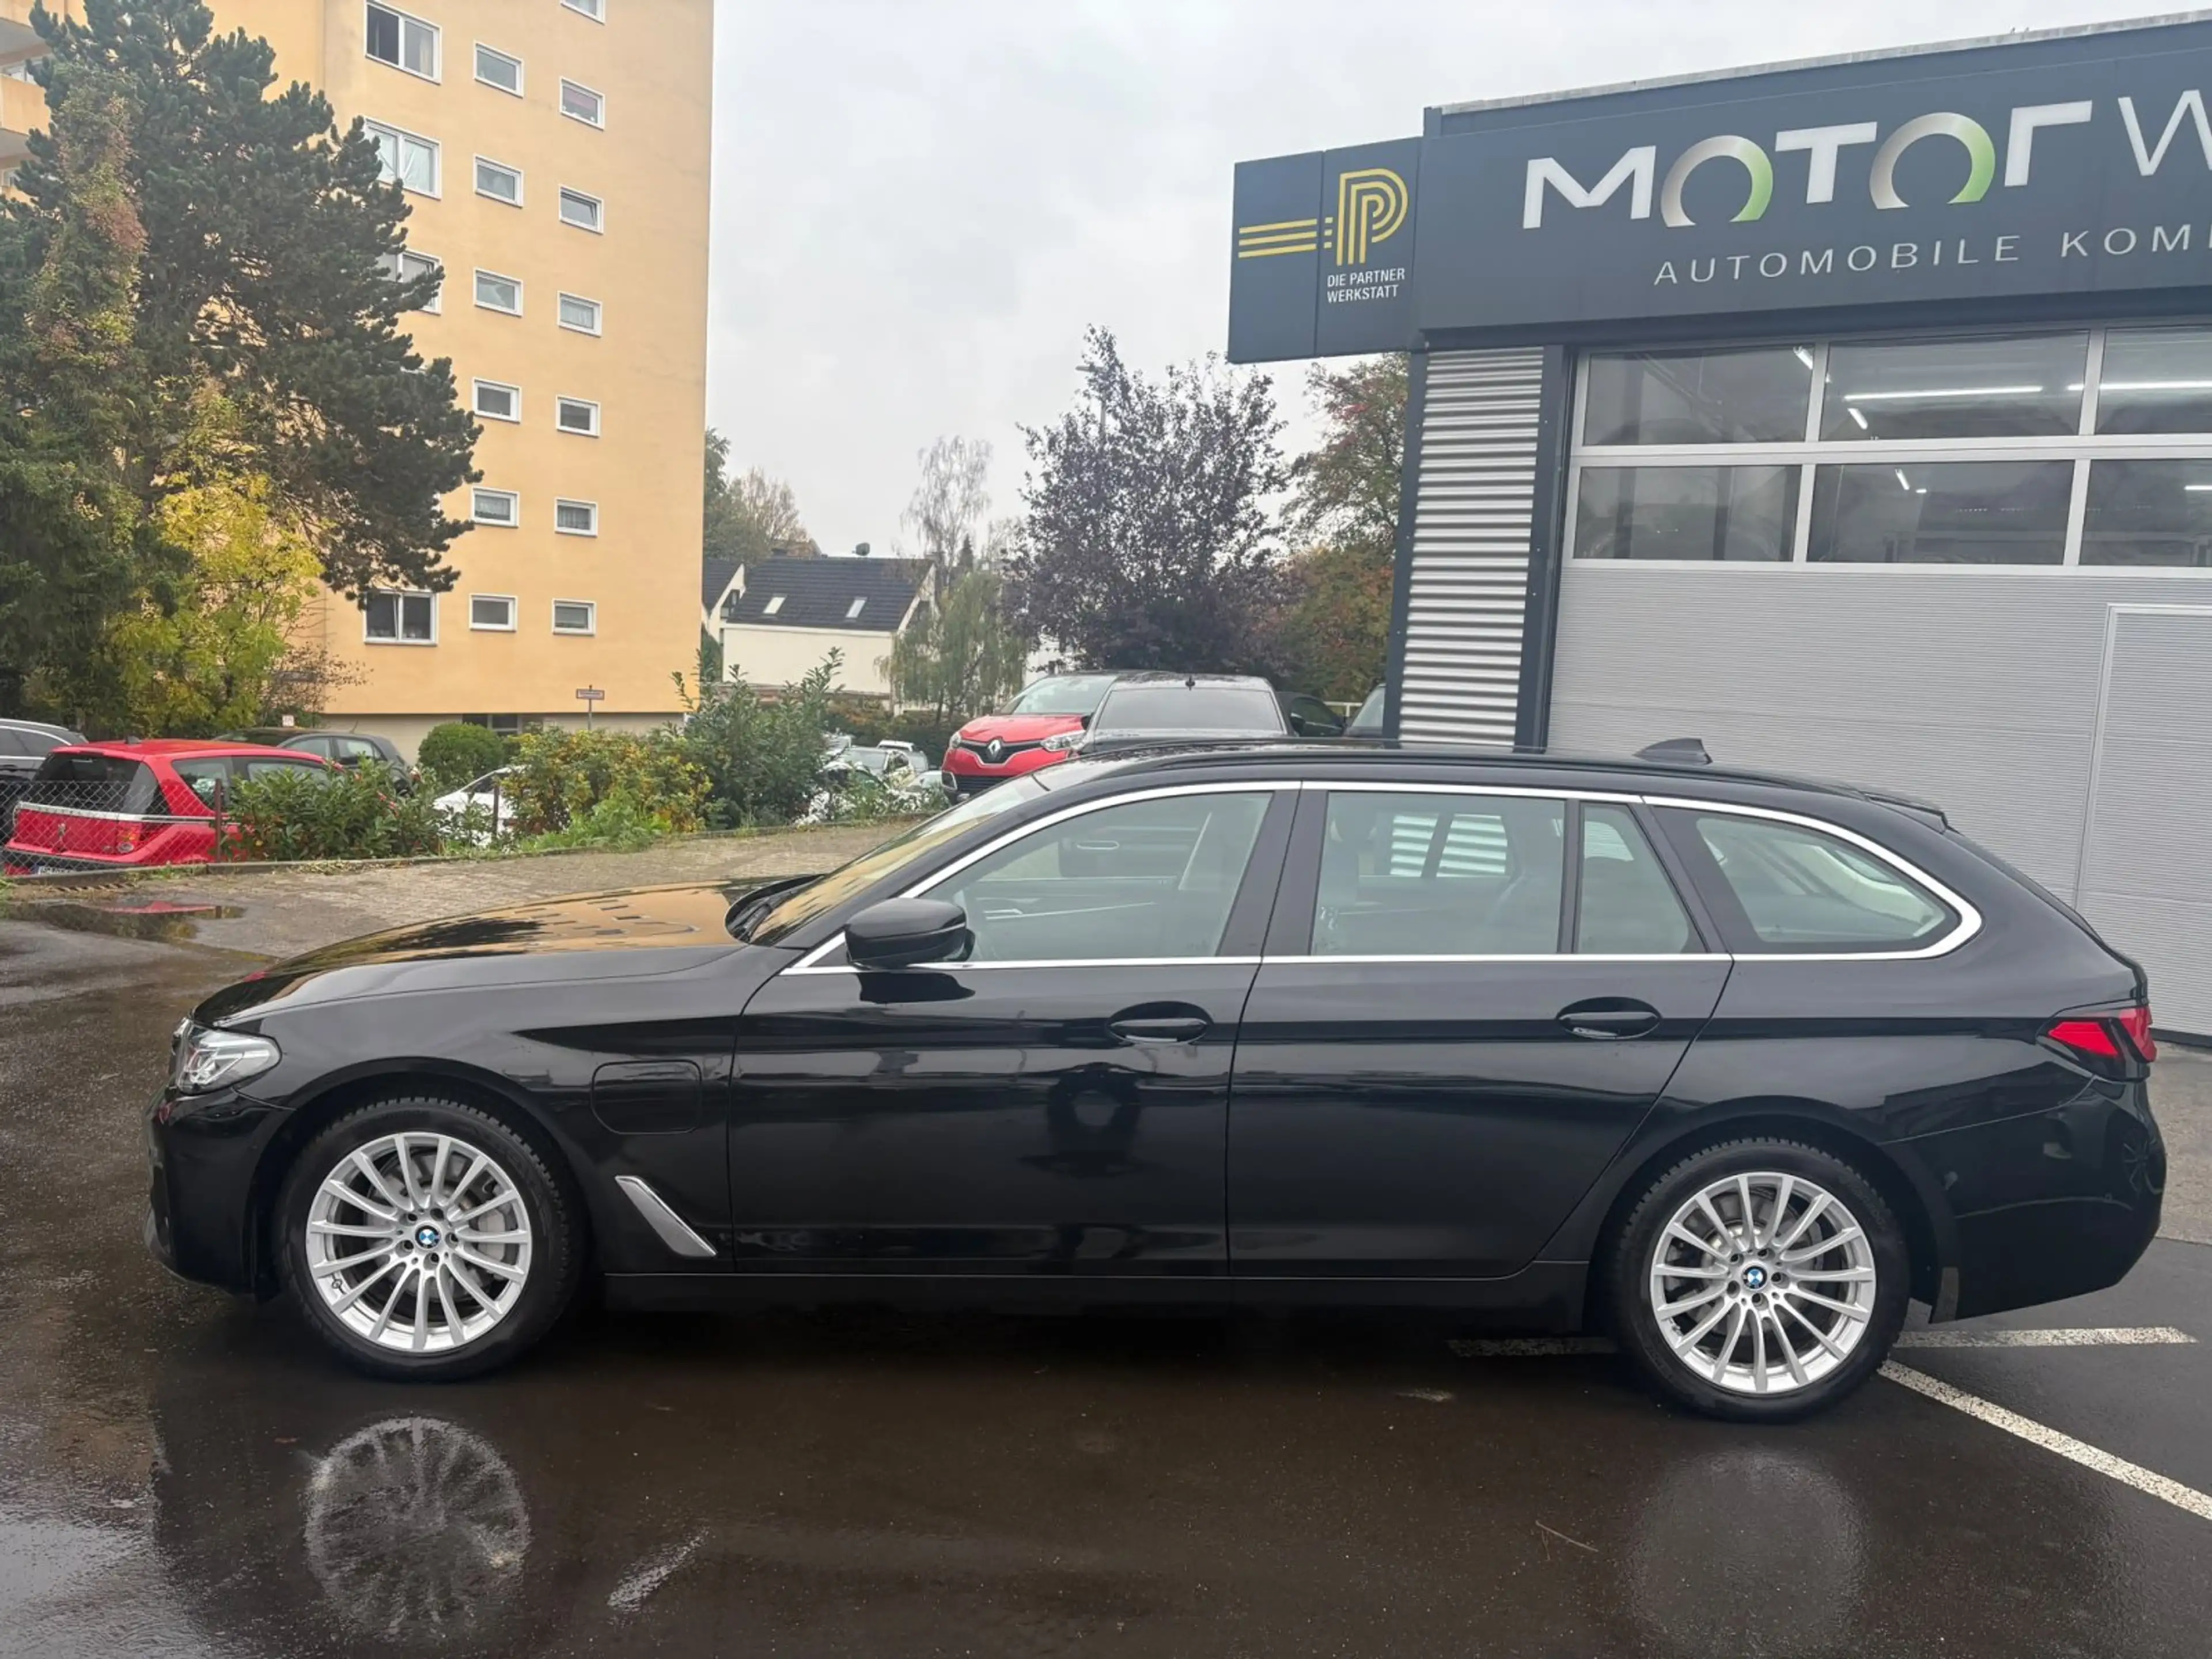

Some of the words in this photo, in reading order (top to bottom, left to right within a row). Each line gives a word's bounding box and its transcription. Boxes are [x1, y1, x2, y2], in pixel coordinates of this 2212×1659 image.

[1654, 235, 2020, 285] AUTOMOBILE
[2061, 224, 2212, 257] KOM
[1327, 274, 1347, 287] DIE
[1350, 267, 1406, 286] PARTNER
[1327, 284, 1399, 304] WERKSTATT
